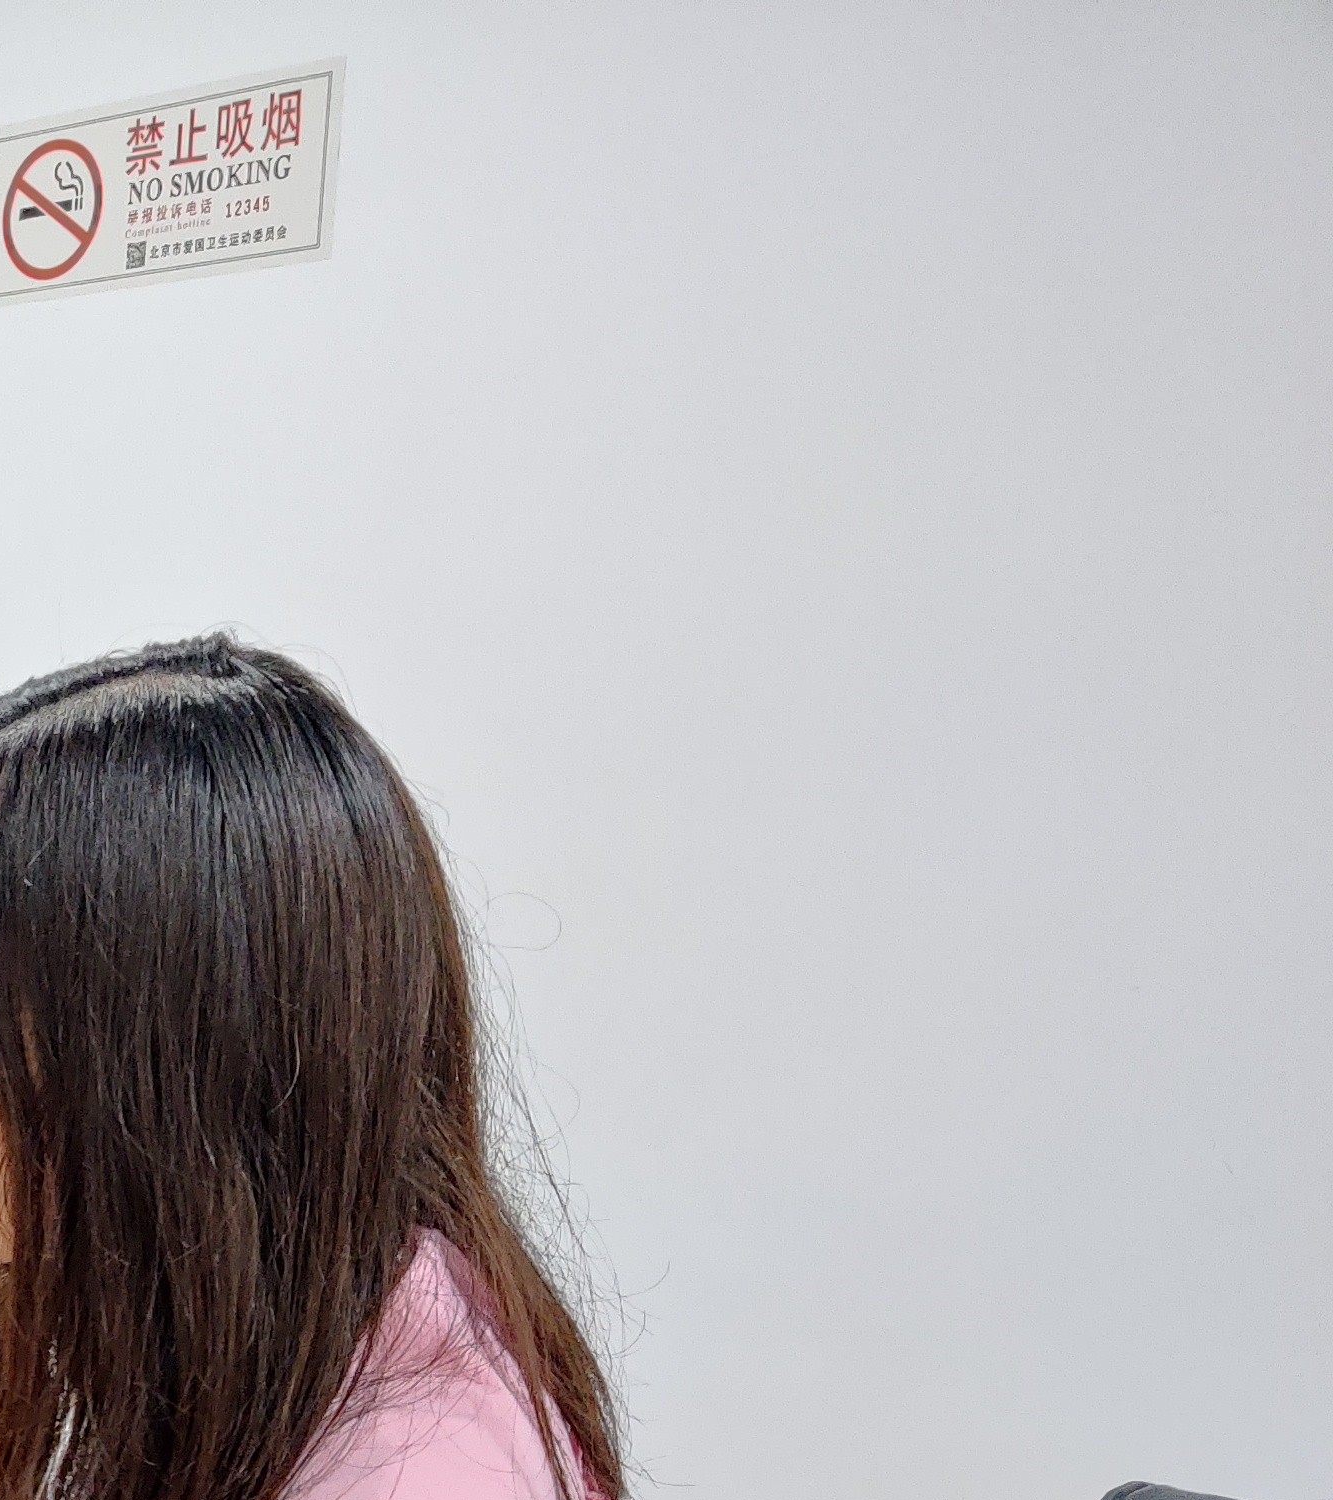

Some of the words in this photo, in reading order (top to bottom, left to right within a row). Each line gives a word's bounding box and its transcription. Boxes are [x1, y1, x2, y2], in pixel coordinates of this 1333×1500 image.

[125, 89, 303, 176] 禁止吸烟
[128, 178, 163, 206] NO
[170, 154, 292, 199] SMOKING
[127, 198, 213, 225] 举报投诉电话
[225, 195, 271, 220] 12345
[125, 222, 174, 240] Complaint
[177, 218, 212, 234] hotline
[149, 225, 288, 260] 北京市爱国卫生运动委员会
